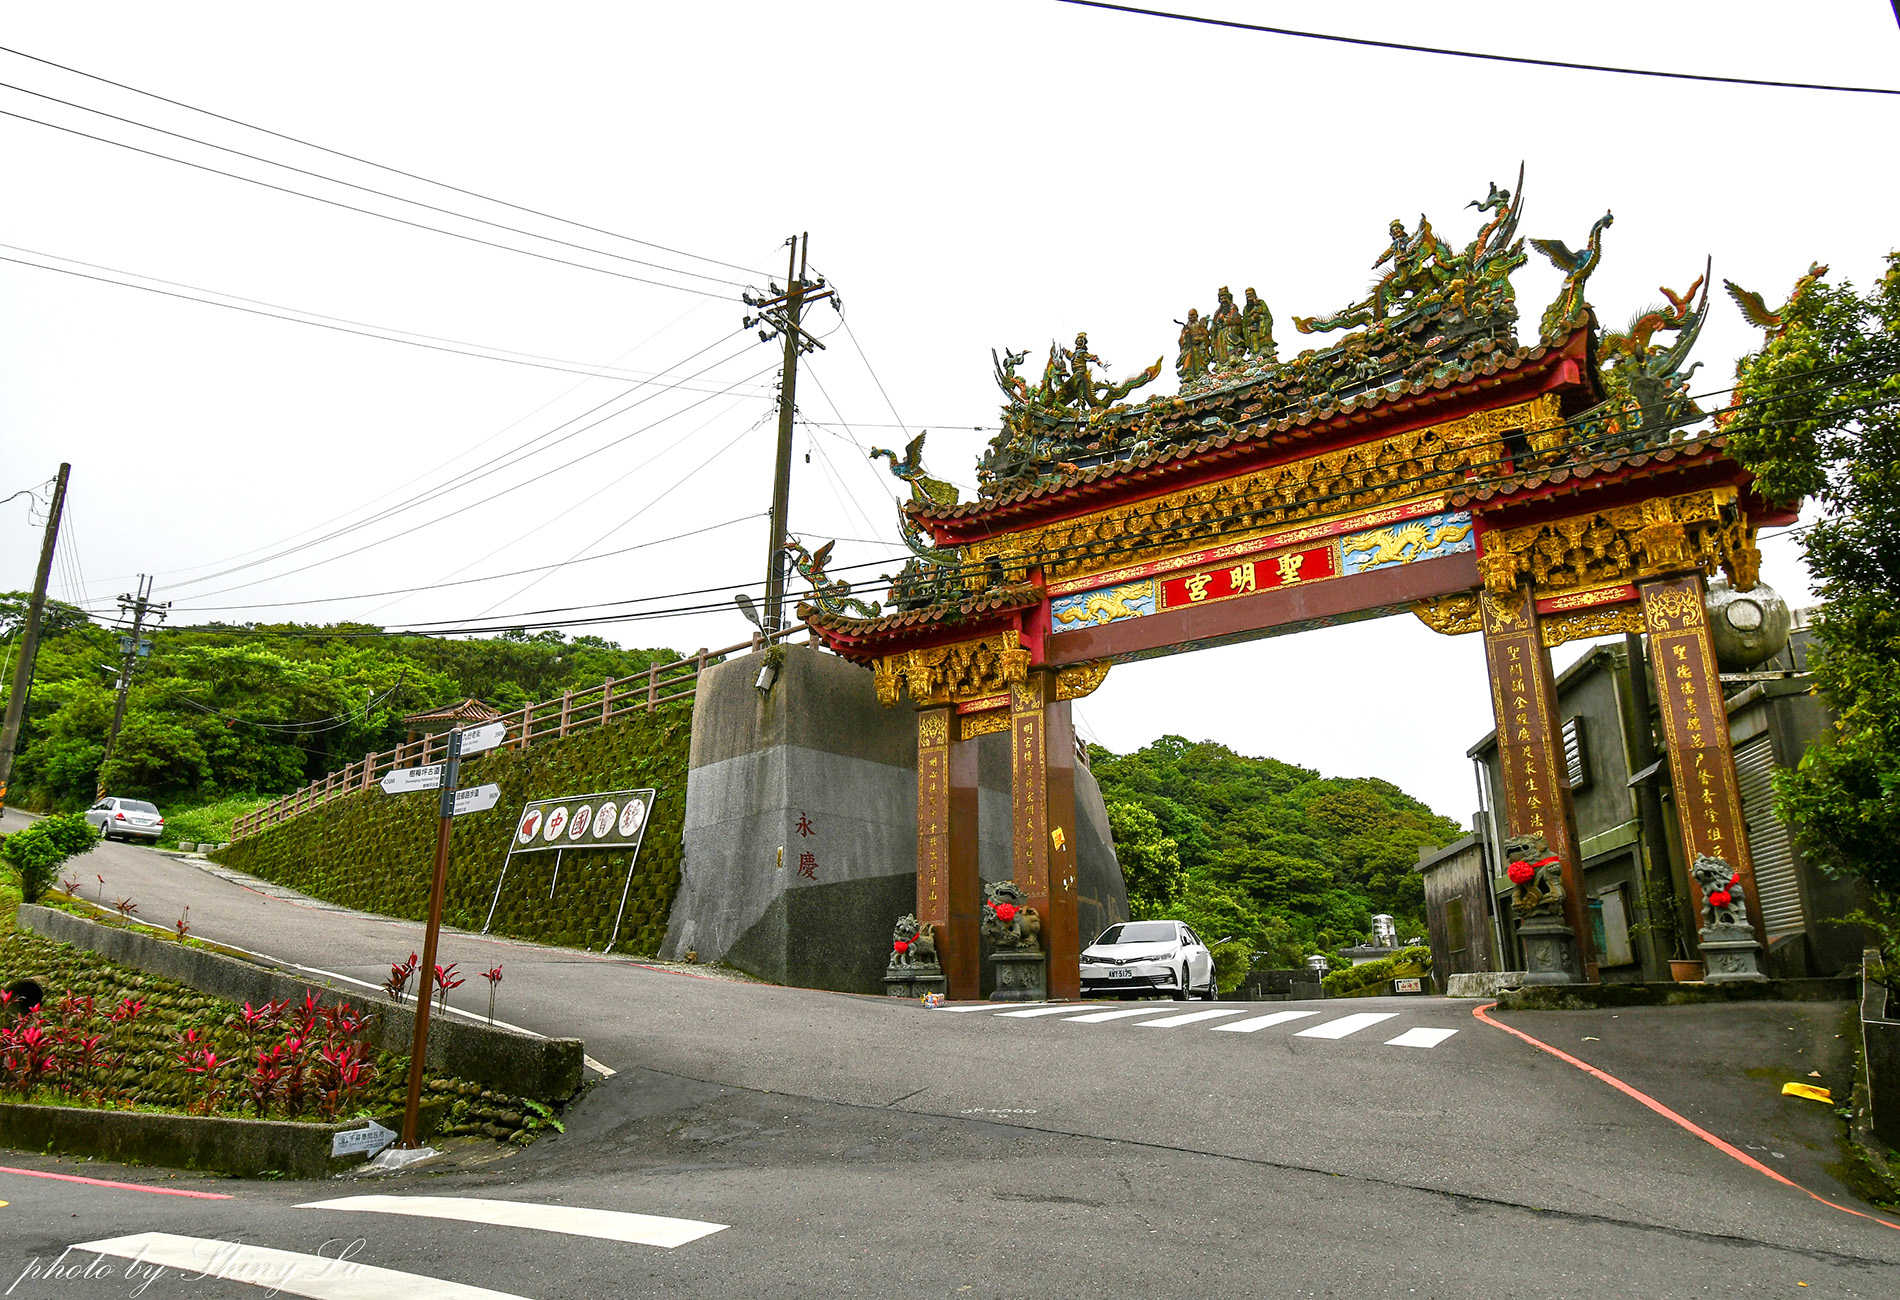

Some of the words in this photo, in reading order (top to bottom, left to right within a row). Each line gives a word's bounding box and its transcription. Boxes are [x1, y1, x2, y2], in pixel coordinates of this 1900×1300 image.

[1184, 553, 1304, 602] 聖明宮
[795, 811, 819, 881] 永慶
